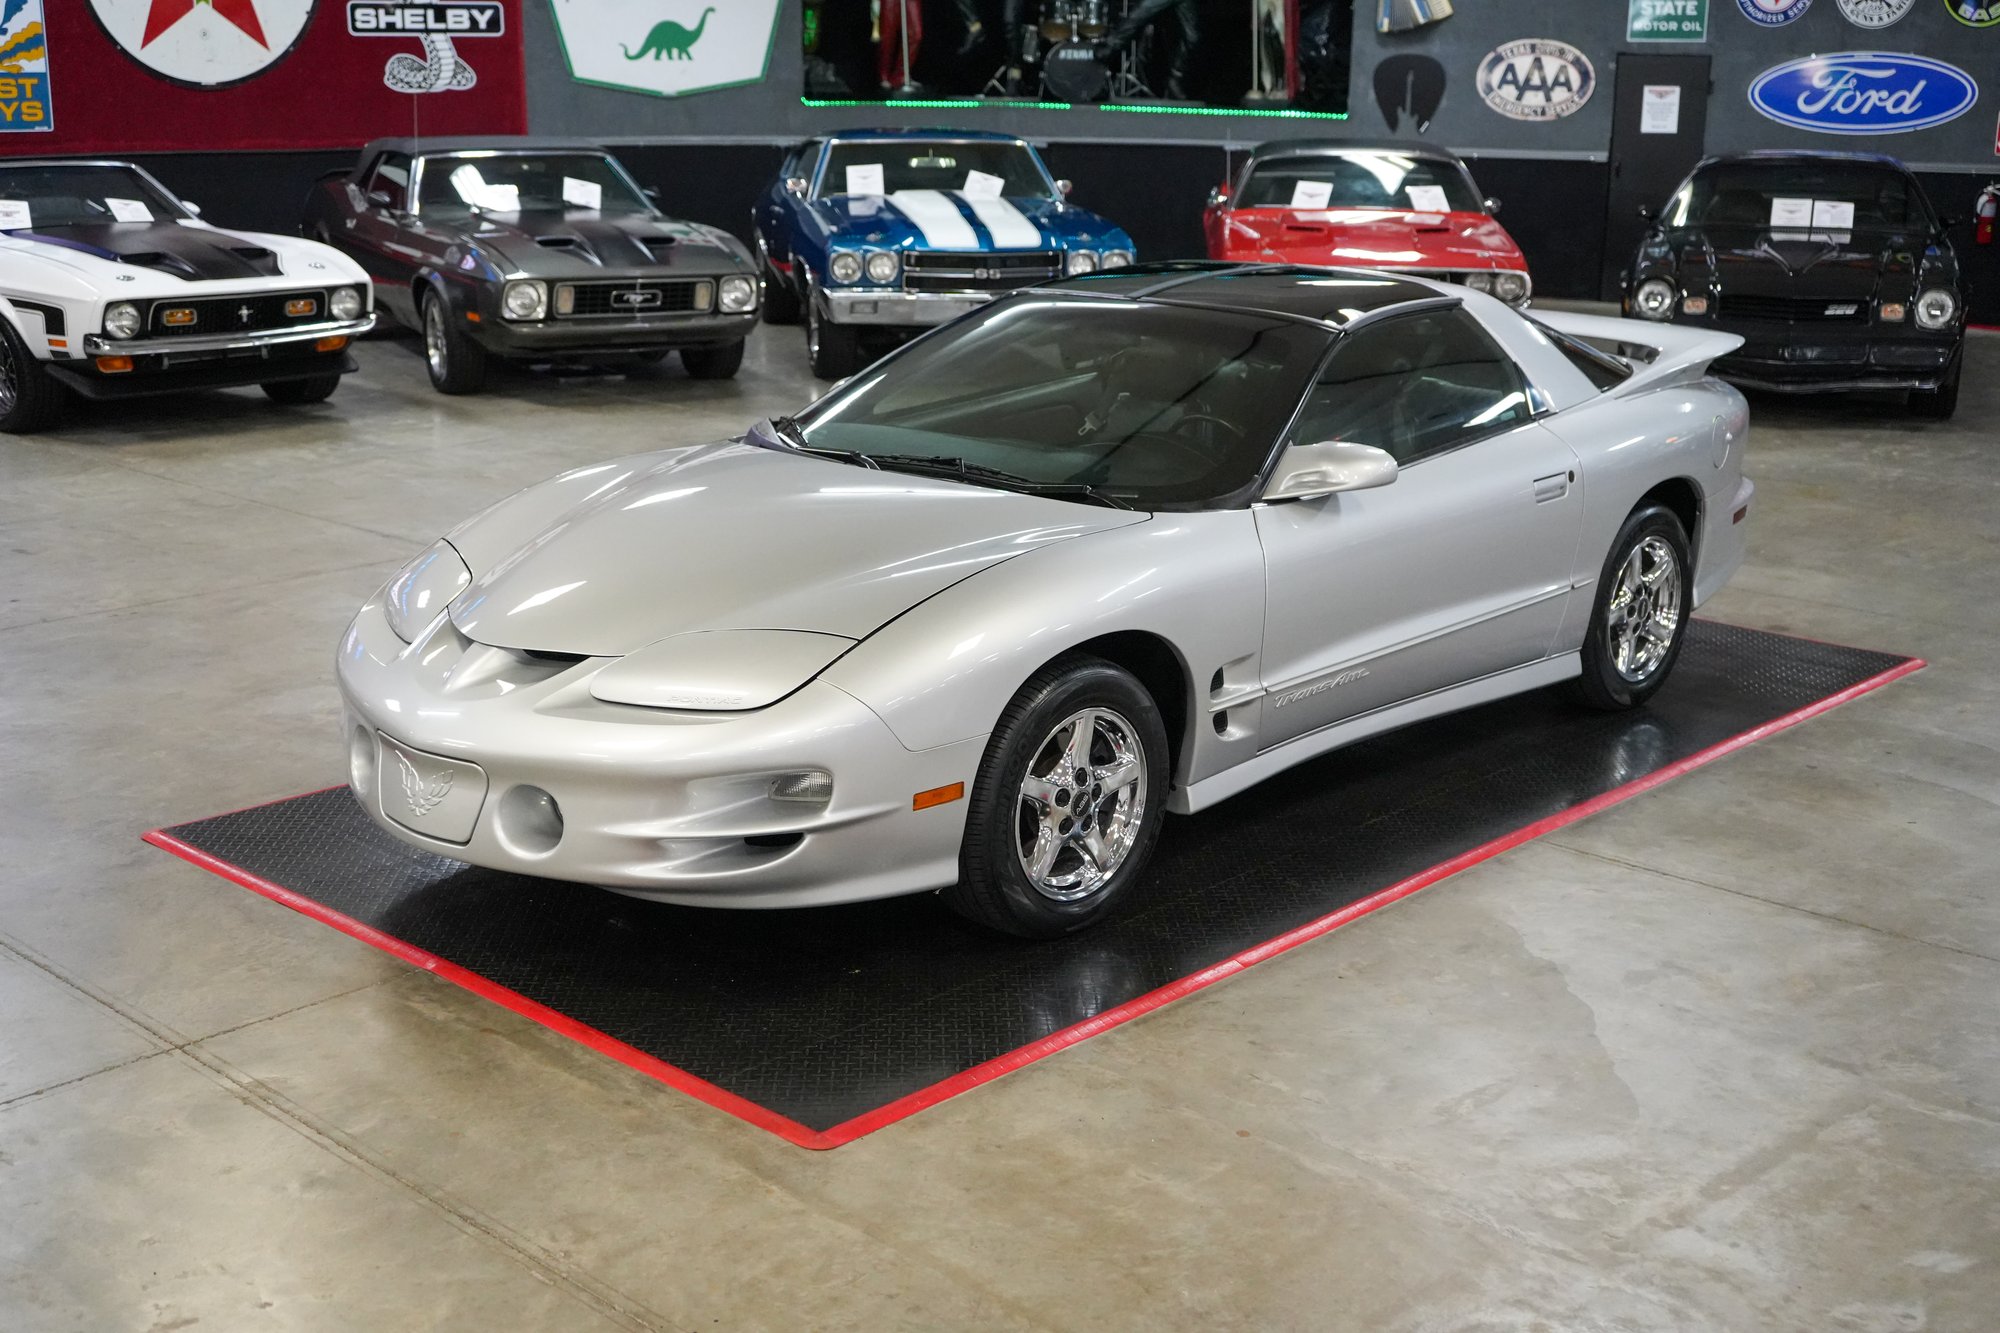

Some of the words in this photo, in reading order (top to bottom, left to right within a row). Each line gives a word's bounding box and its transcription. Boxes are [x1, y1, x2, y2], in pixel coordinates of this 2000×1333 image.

[1640, 0, 1699, 16] STATE
[354, 8, 494, 30] SHELBY
[1632, 20, 1679, 32] MOTOR
[1681, 20, 1703, 32] OIL
[1497, 56, 1573, 103] AAA
[1797, 65, 1927, 114] Ford
[667, 694, 743, 706] PONTIAC
